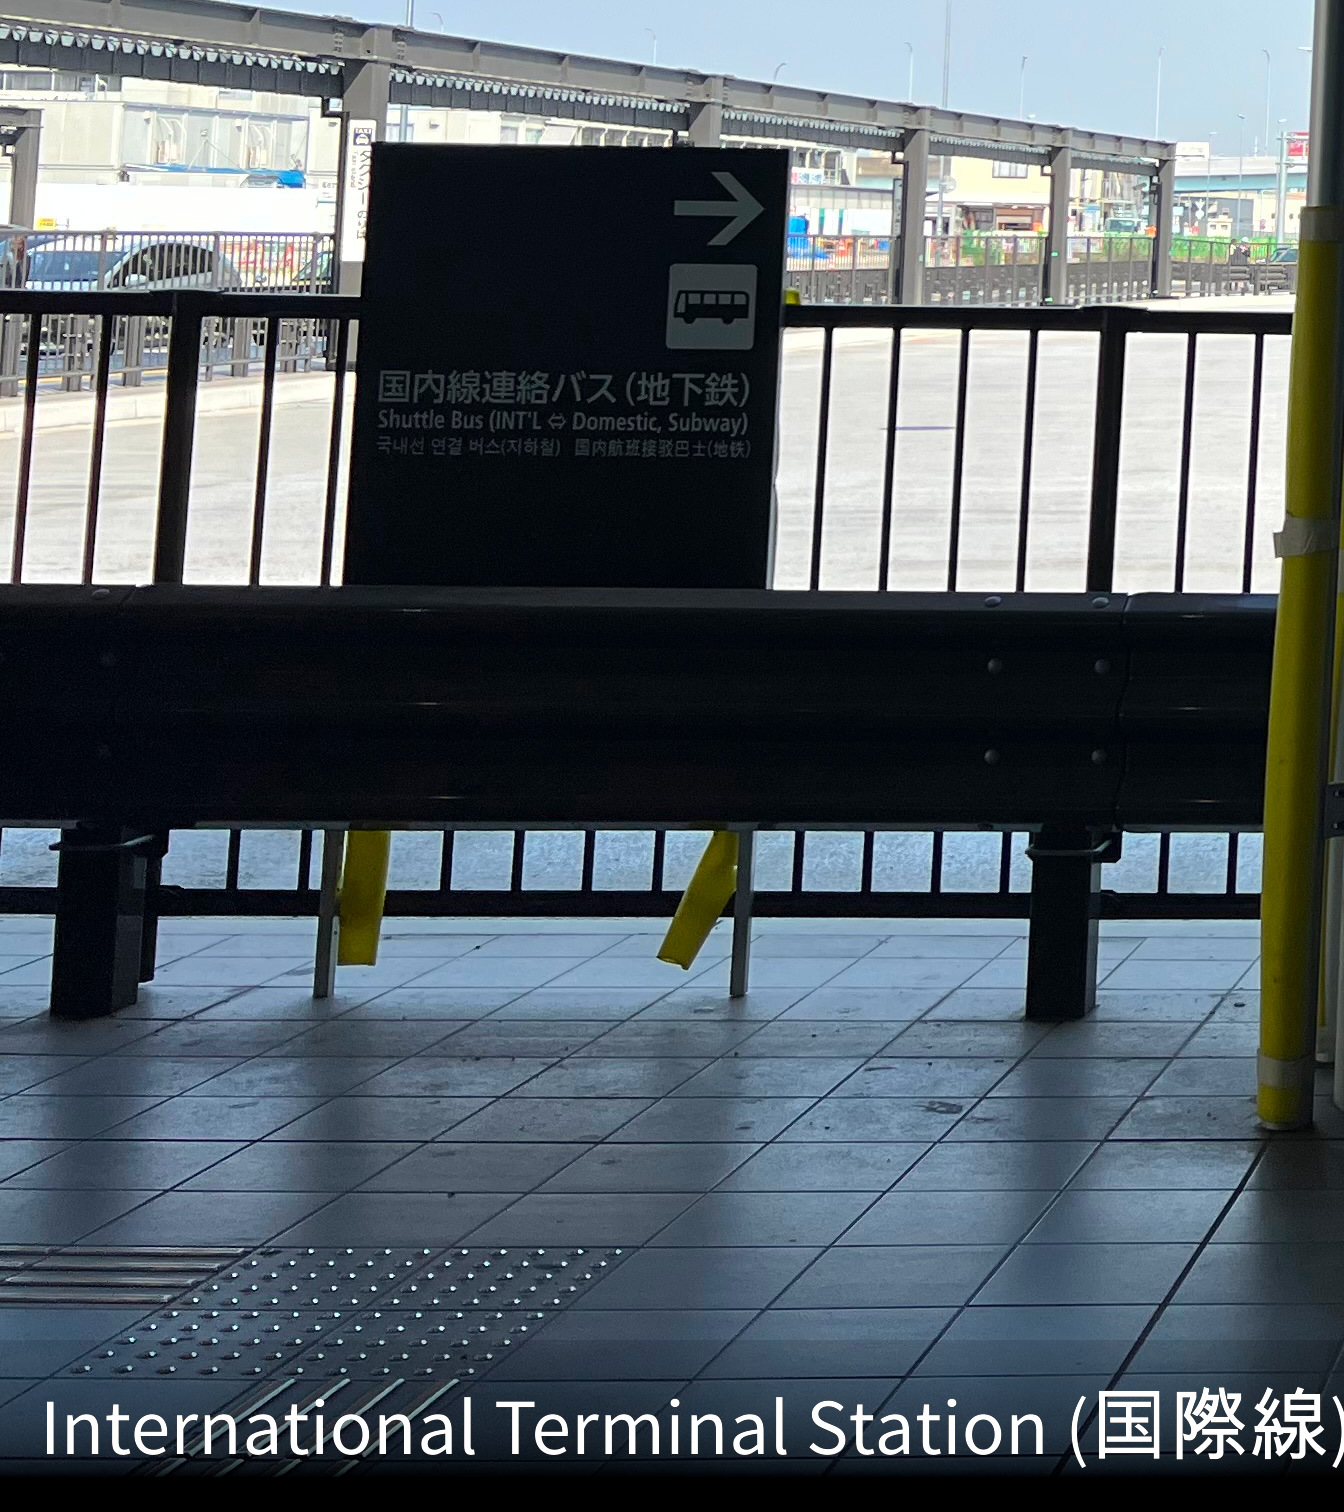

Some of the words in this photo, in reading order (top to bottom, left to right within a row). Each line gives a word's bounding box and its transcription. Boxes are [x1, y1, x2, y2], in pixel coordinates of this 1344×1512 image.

[377, 409, 445, 430] Shuttle
[451, 411, 483, 430] Bus
[489, 410, 542, 433] (INT'L
[572, 412, 663, 434] Domestic,
[668, 413, 749, 436] Subway)
[376, 436, 426, 454] 국내선
